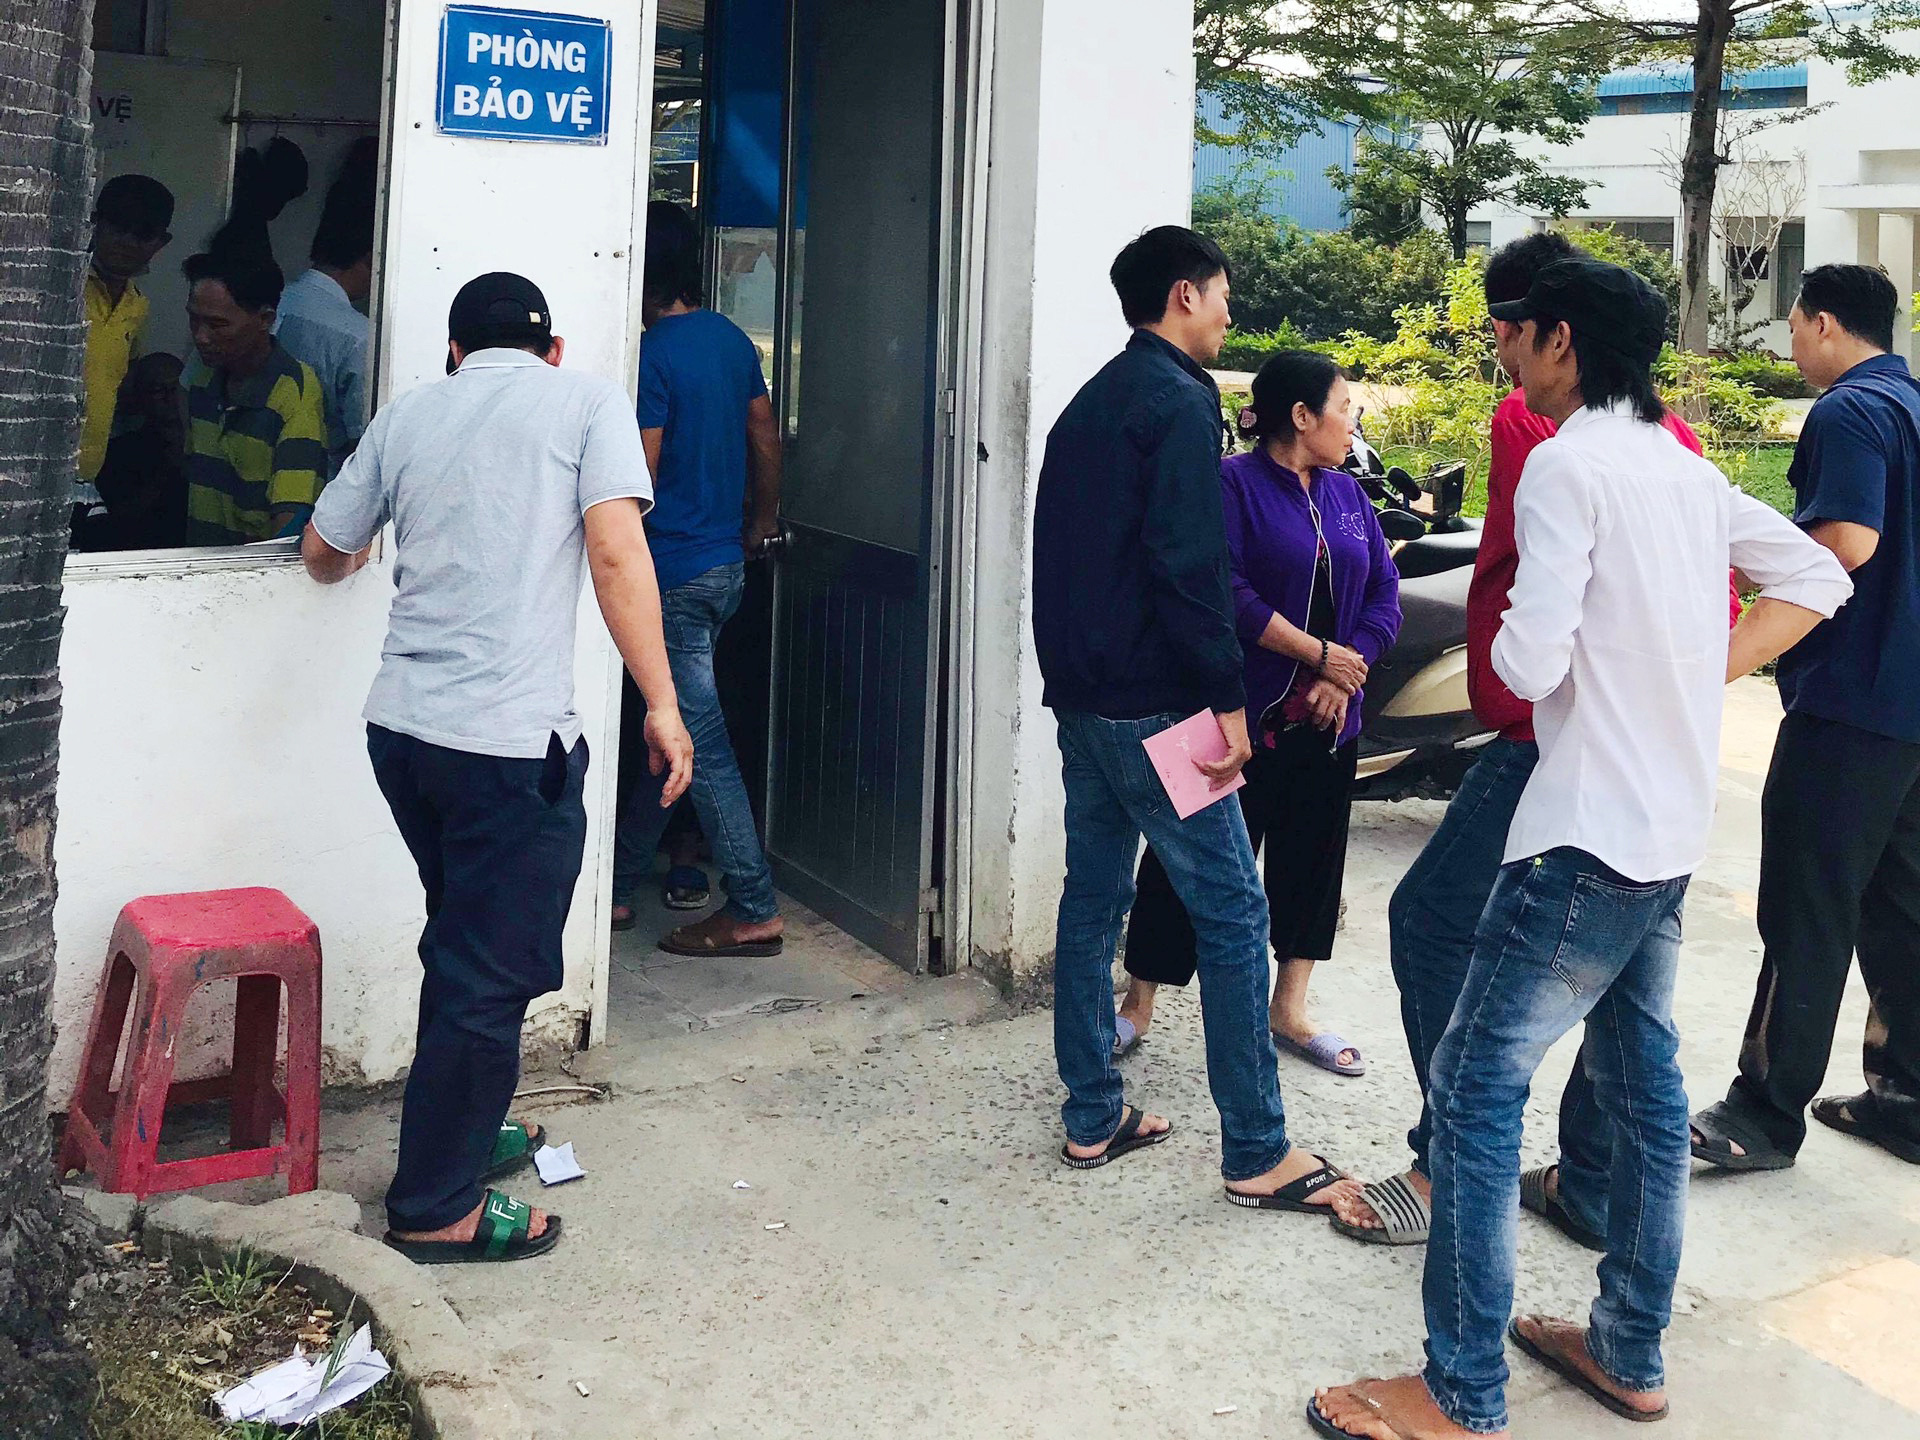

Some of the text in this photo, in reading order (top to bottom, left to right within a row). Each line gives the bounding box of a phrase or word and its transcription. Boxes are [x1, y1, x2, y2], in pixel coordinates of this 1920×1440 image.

[467, 28, 587, 74] PHÒNG
[97, 94, 132, 123] VỆ
[453, 75, 593, 131] BẢO VỆ
